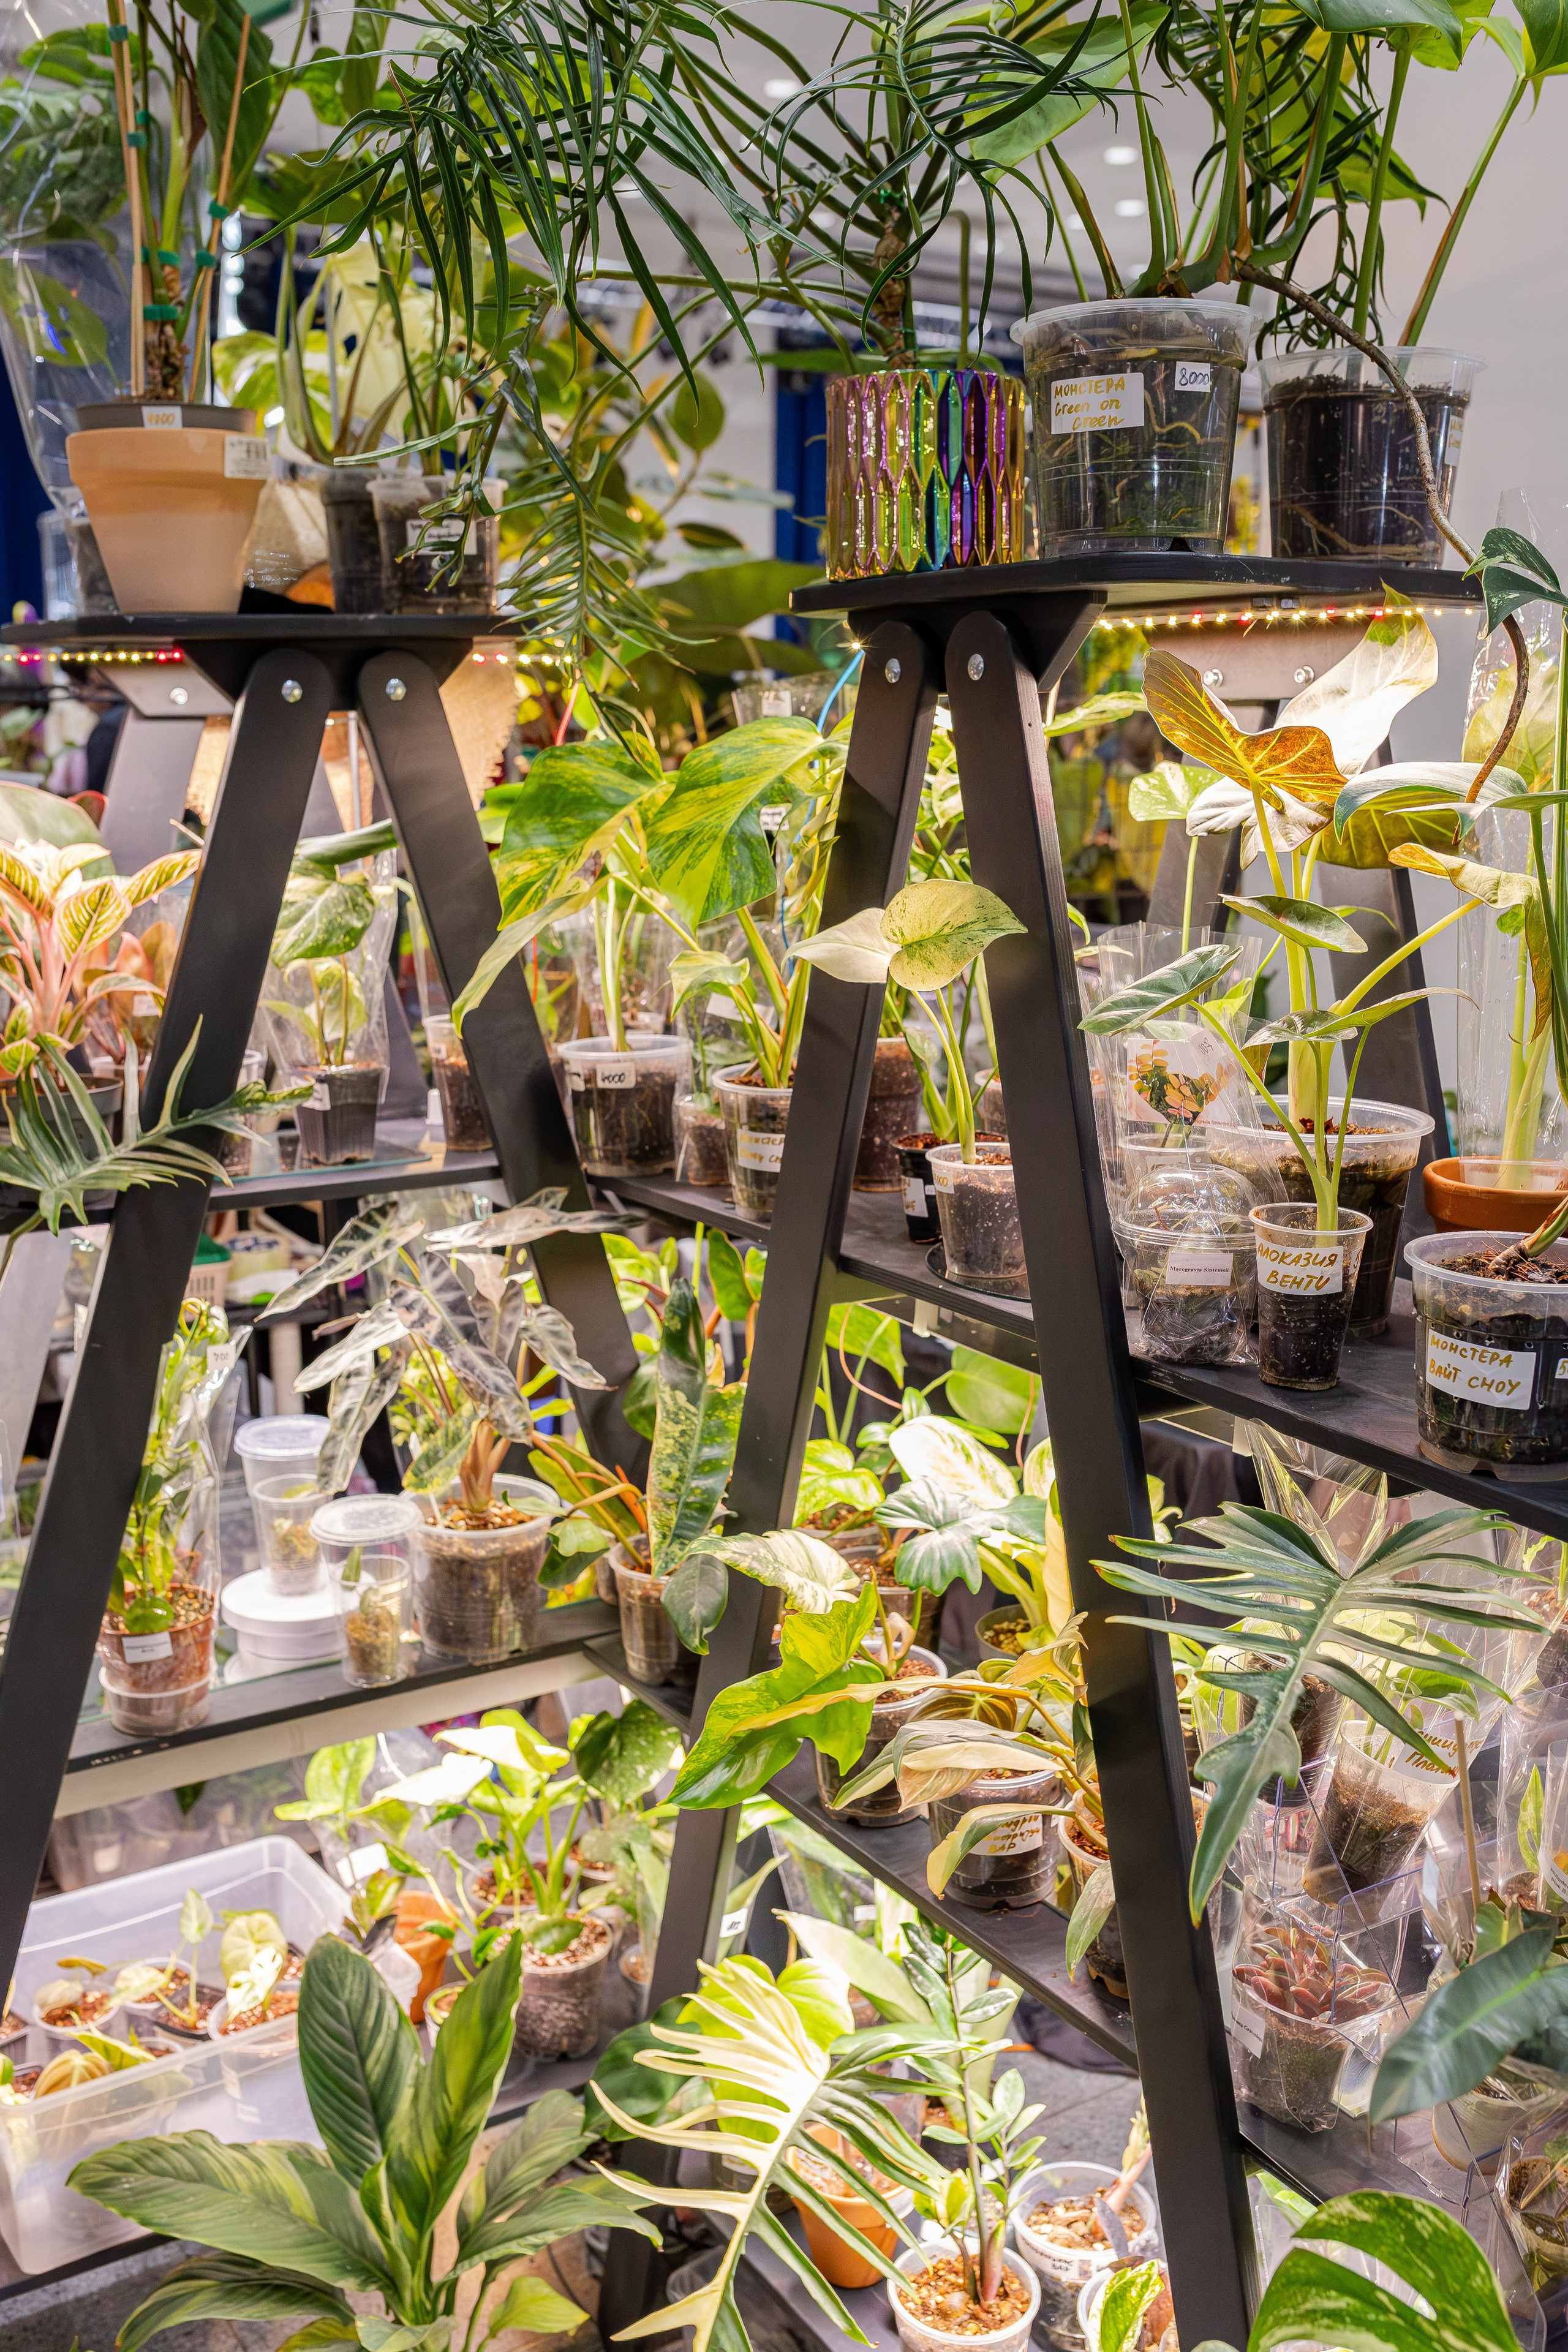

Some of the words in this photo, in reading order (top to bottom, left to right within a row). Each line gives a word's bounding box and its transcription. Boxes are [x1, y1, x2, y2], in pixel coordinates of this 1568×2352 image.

[1054, 376, 1125, 399] МОНСТЕРА
[1055, 401, 1090, 417] Green
[1100, 398, 1121, 411] on
[1257, 1242, 1338, 1268] АЛОКАЗИЯ
[1430, 1334, 1513, 1368] МОНСТЕРА
[1558, 1360, 1568, 1376] 5
[1468, 1376, 1521, 1396] СНОУ
